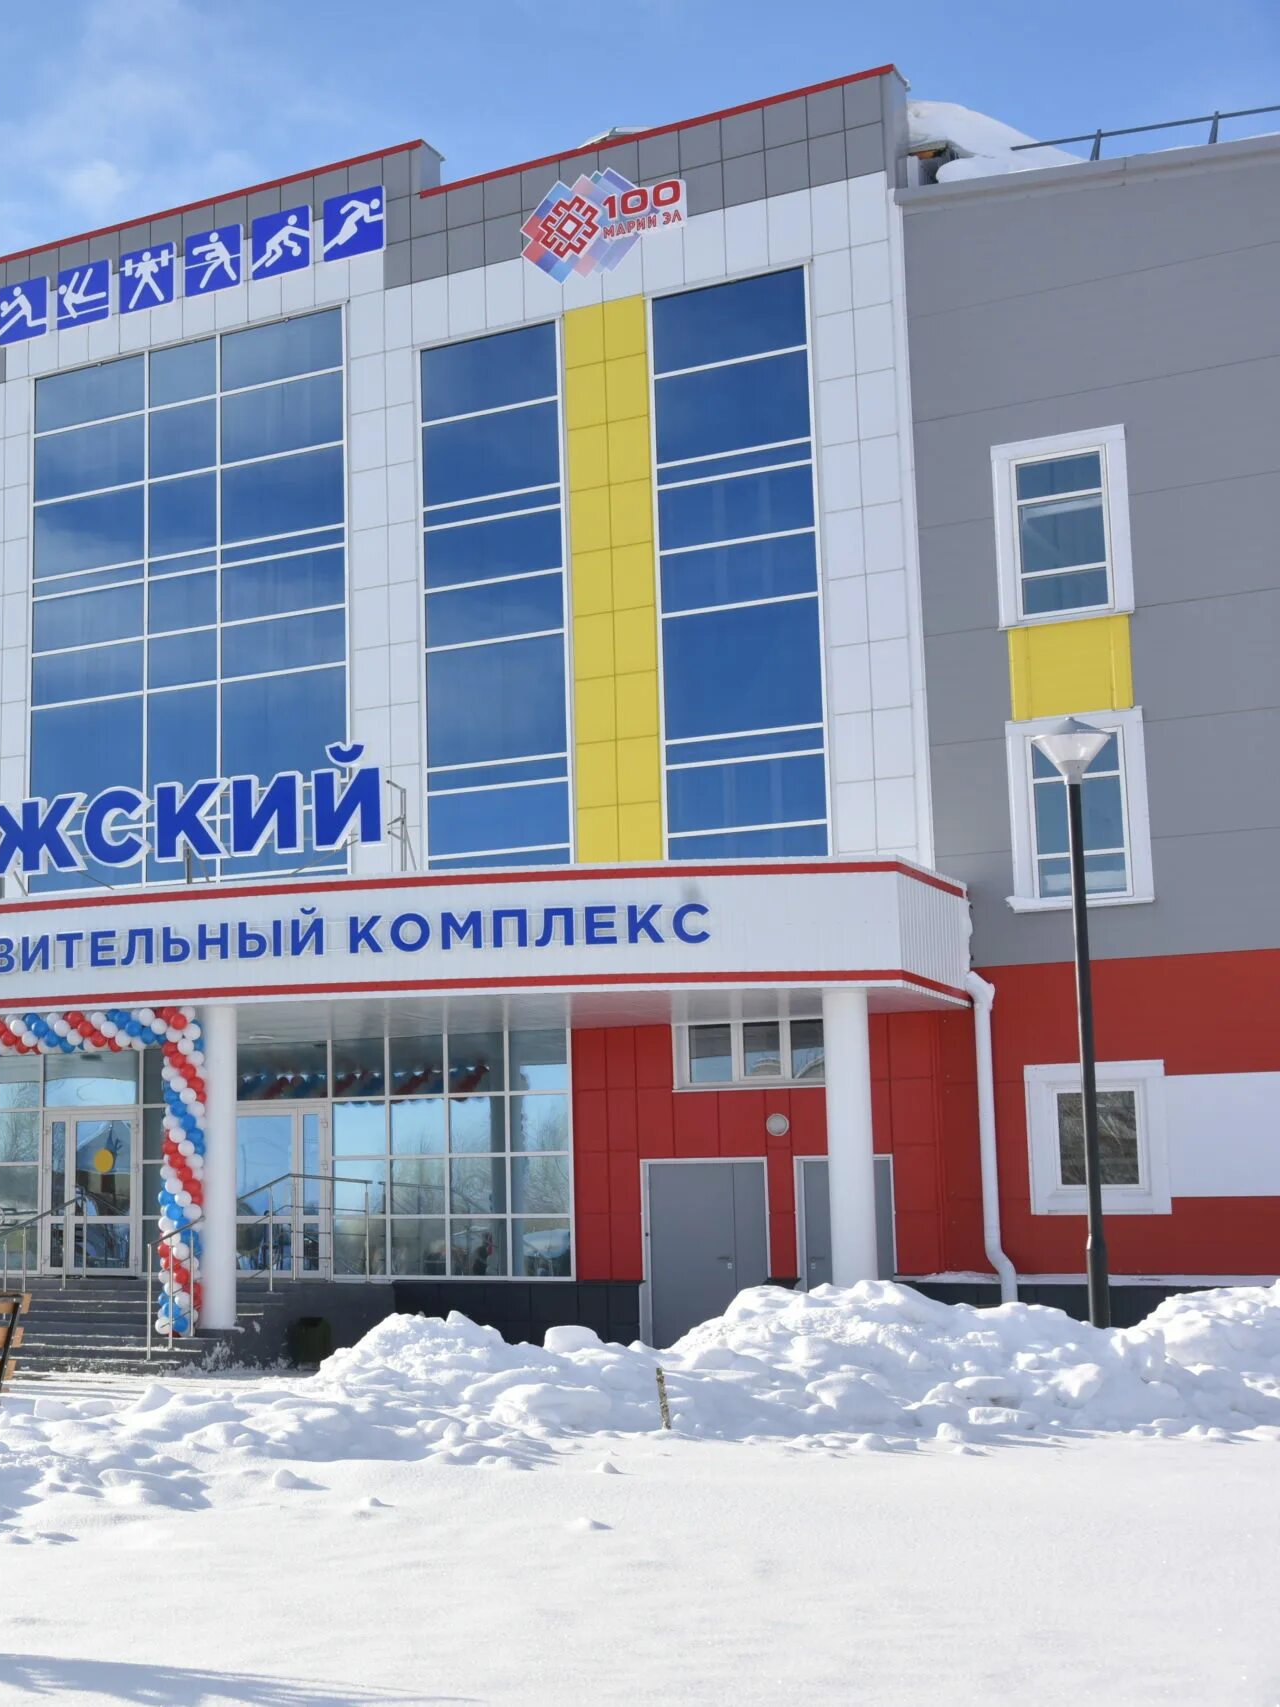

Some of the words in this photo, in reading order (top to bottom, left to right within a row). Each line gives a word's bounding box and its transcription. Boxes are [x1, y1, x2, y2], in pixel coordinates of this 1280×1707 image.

[602, 179, 681, 219] 100
[662, 209, 682, 225] ЭЛ
[349, 903, 711, 954] КОМПЛЕКС
